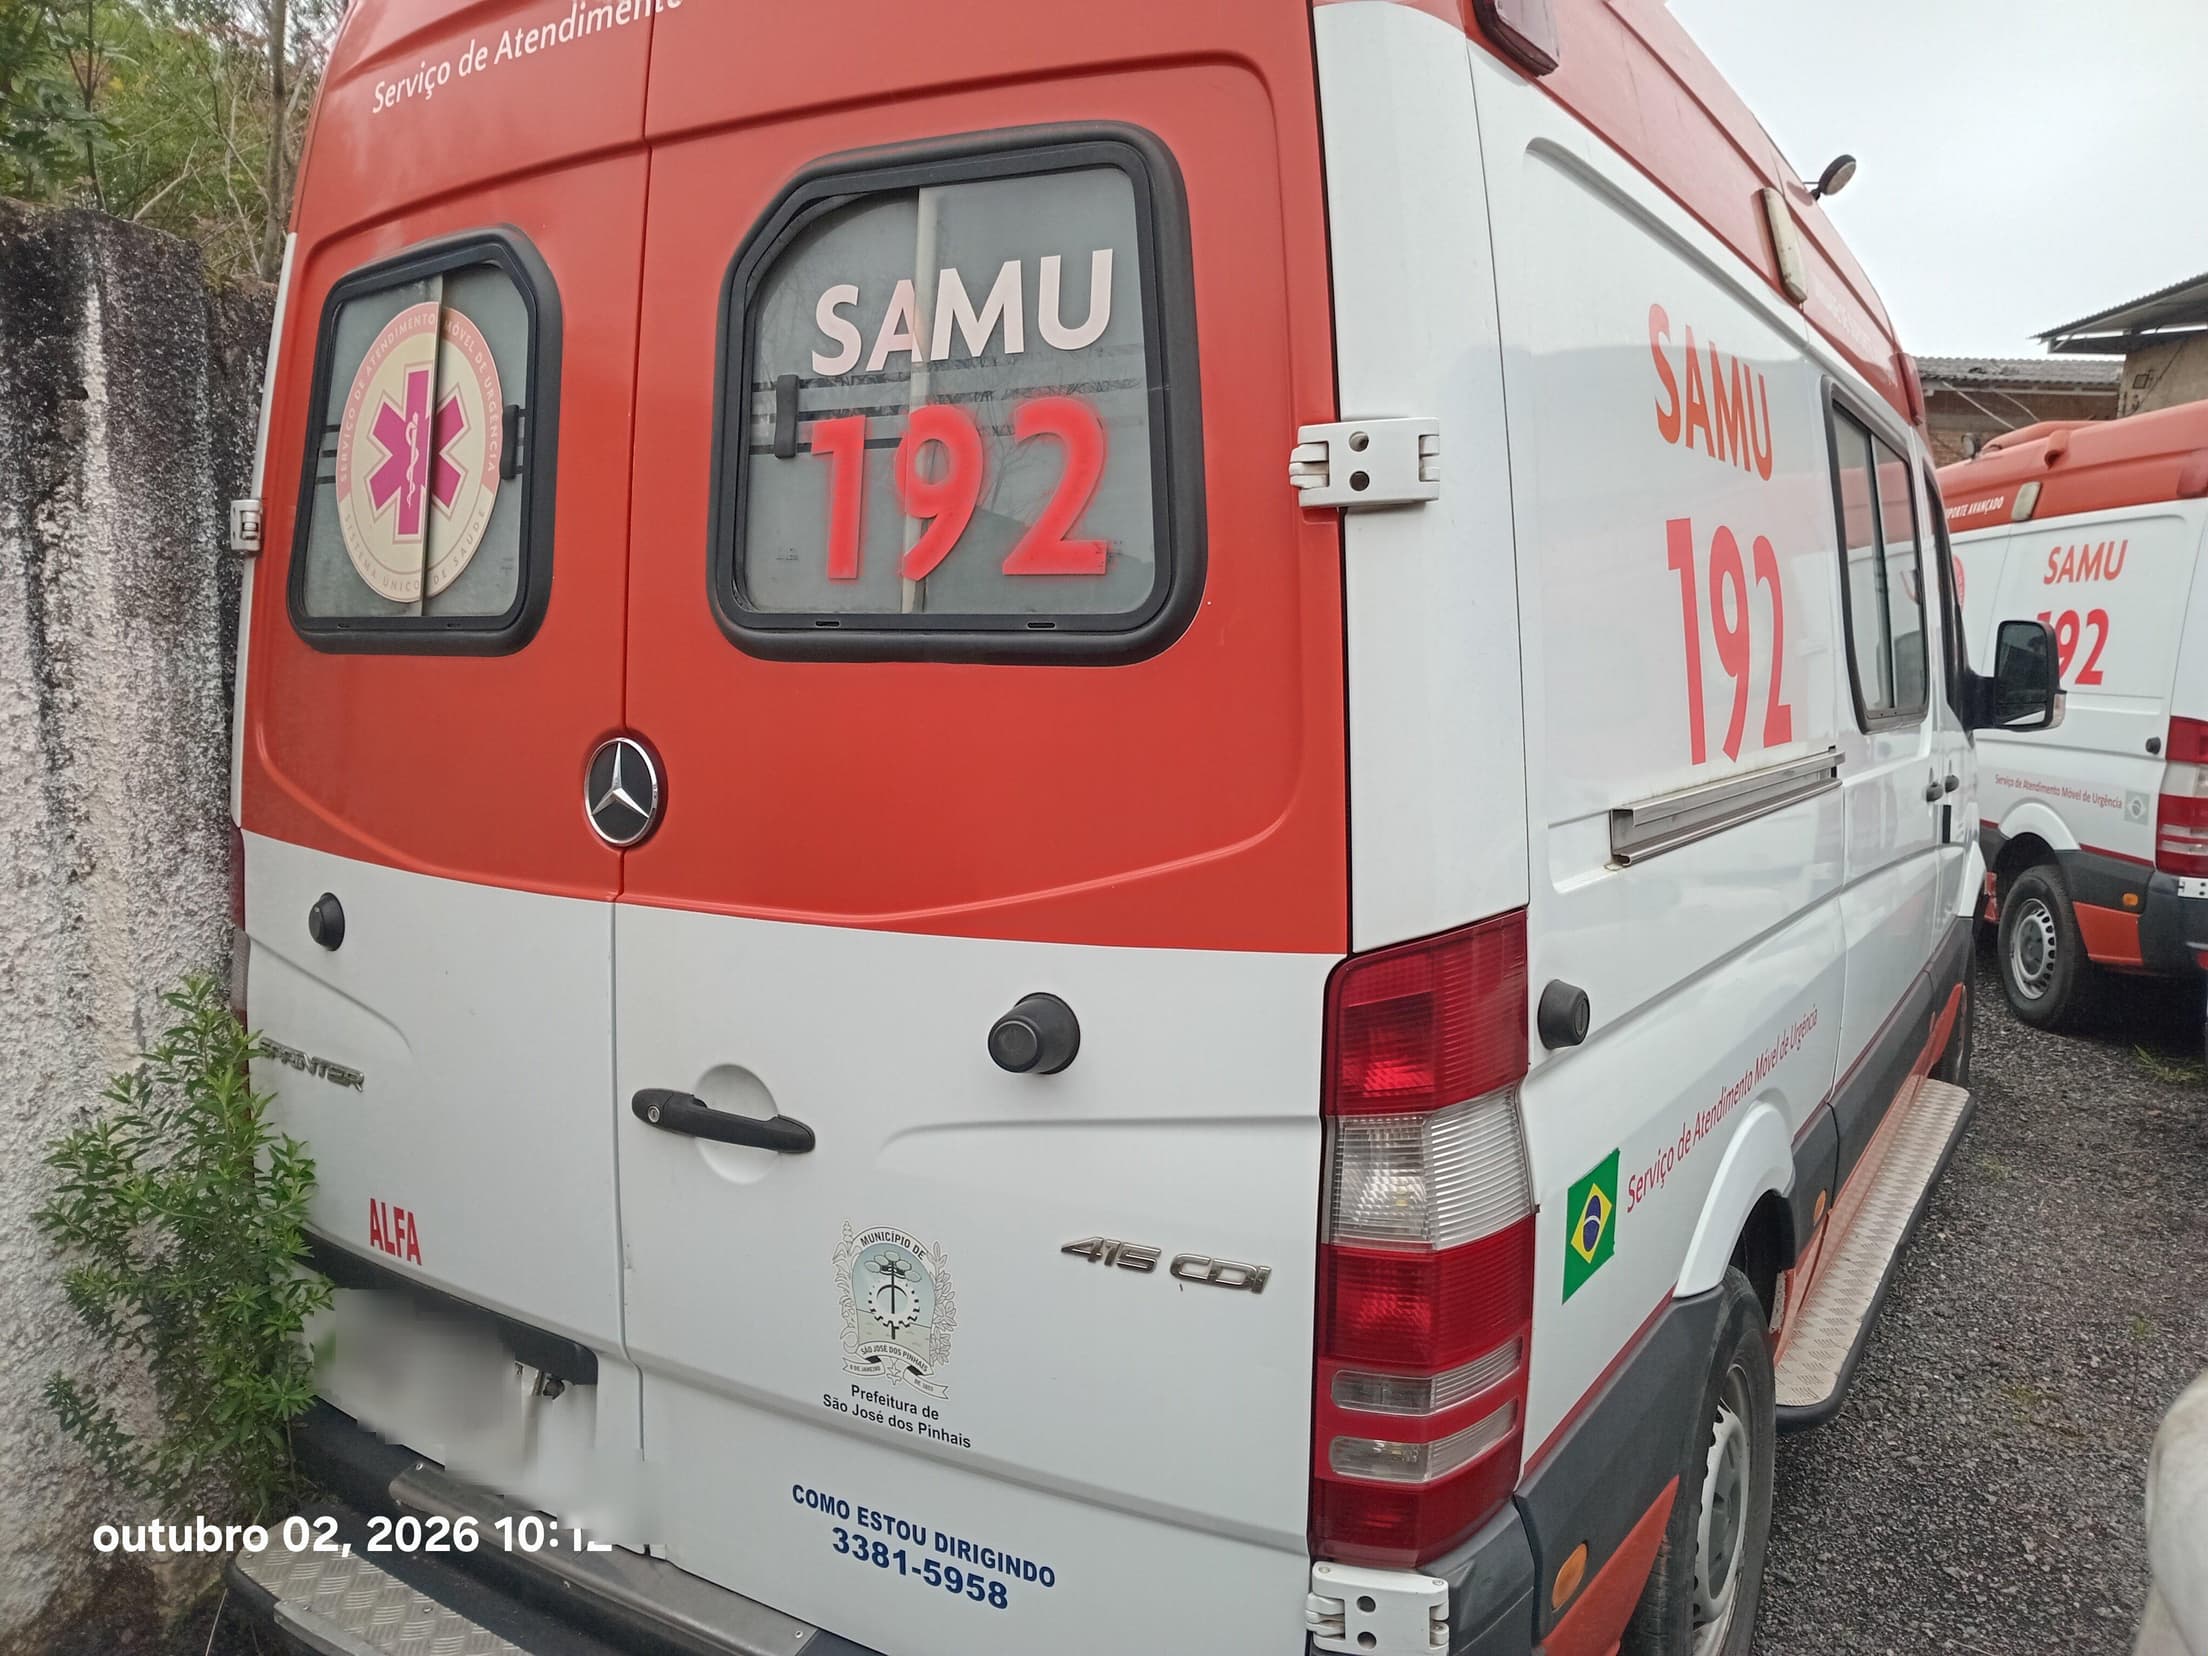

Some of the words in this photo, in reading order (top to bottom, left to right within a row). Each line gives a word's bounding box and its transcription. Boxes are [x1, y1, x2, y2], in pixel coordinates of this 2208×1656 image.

[373, 62, 450, 113] Serviço
[457, 39, 487, 77] de
[811, 248, 1113, 376] SAMU
[354, 380, 366, 401] DE
[364, 313, 436, 378] ATENDIMENTO
[474, 351, 488, 374] DE
[1647, 302, 1773, 481] SAMU
[810, 396, 1108, 582] 192
[432, 572, 448, 585] DE
[2043, 539, 2129, 585] SAMU
[1665, 517, 1793, 766] 192
[1995, 774, 2015, 788] Serviço
[2023, 780, 2061, 796] Atendimento
[2061, 786, 2082, 801] Móvel
[2082, 791, 2091, 803] de
[2092, 792, 2122, 809] Urgência
[1627, 1146, 1674, 1213] Serviço
[1677, 1122, 1691, 1162] de
[1692, 1069, 1753, 1146] Atendimento
[1755, 1034, 1780, 1087] Móvel
[1780, 1028, 1789, 1061] de
[368, 1197, 422, 1266] ALFA
[860, 1230, 911, 1248] MUNICÍPIO
[912, 1244, 927, 1261] DE
[1061, 1235, 1163, 1273] 415
[1169, 1252, 1272, 1295] CDI
[889, 1346, 902, 1356] DOS
[902, 1350, 928, 1372] PINHAIS
[823, 1394, 848, 1413] São
[852, 1403, 884, 1424] José
[888, 1415, 914, 1432] dos
[918, 1422, 971, 1448] Pinhais
[851, 1384, 918, 1415] Prefeitura
[921, 1405, 939, 1420] de
[792, 1484, 851, 1522] COMO
[856, 1504, 927, 1547] ESTOU
[934, 1530, 1056, 1588] DIRIGINDO
[831, 1525, 1010, 1610] 3381-5958
